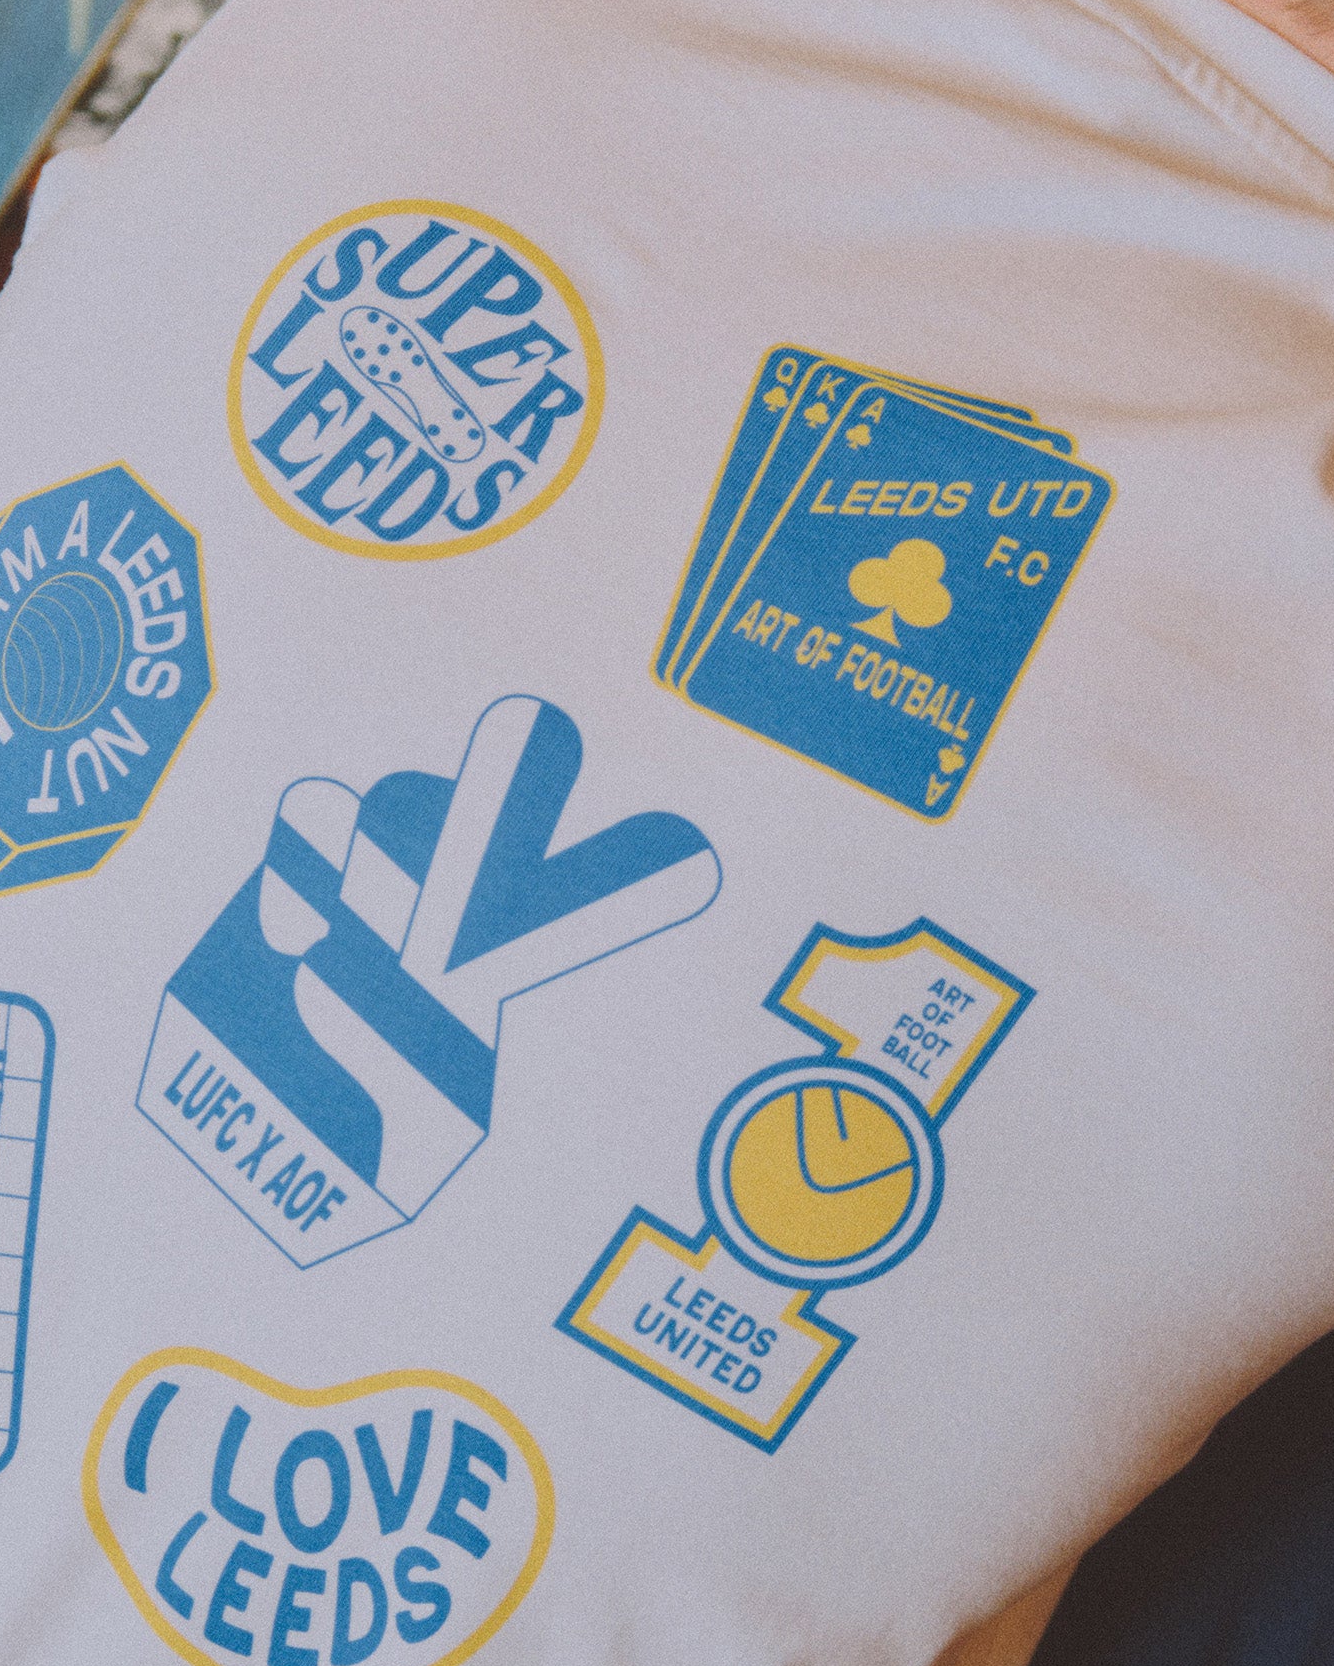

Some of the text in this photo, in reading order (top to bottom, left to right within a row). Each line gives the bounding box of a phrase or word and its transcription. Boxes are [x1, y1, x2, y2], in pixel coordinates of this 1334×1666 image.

[302, 220, 584, 464] SUPER
[775, 357, 799, 386] Q
[817, 373, 845, 401] K
[248, 290, 528, 541] LEEDS
[860, 397, 887, 423] A
[810, 479, 1093, 520] LEEDS UTD
[56, 499, 90, 560] A
[984, 534, 1050, 587] F.C
[97, 509, 187, 700] LEEDS
[731, 598, 977, 741] ART OF FOOTBALL
[26, 705, 150, 814] NUT
[924, 772, 952, 807] A
[920, 1001, 956, 1030] OF
[927, 977, 977, 1013] ART
[880, 1035, 933, 1081] BALL
[893, 1013, 953, 1060] FOOT
[162, 1049, 348, 1234] LUFC X AOF
[662, 1275, 779, 1359] LEEDS
[632, 1302, 764, 1396] UNITED
[123, 1380, 509, 1560] I LOVE
